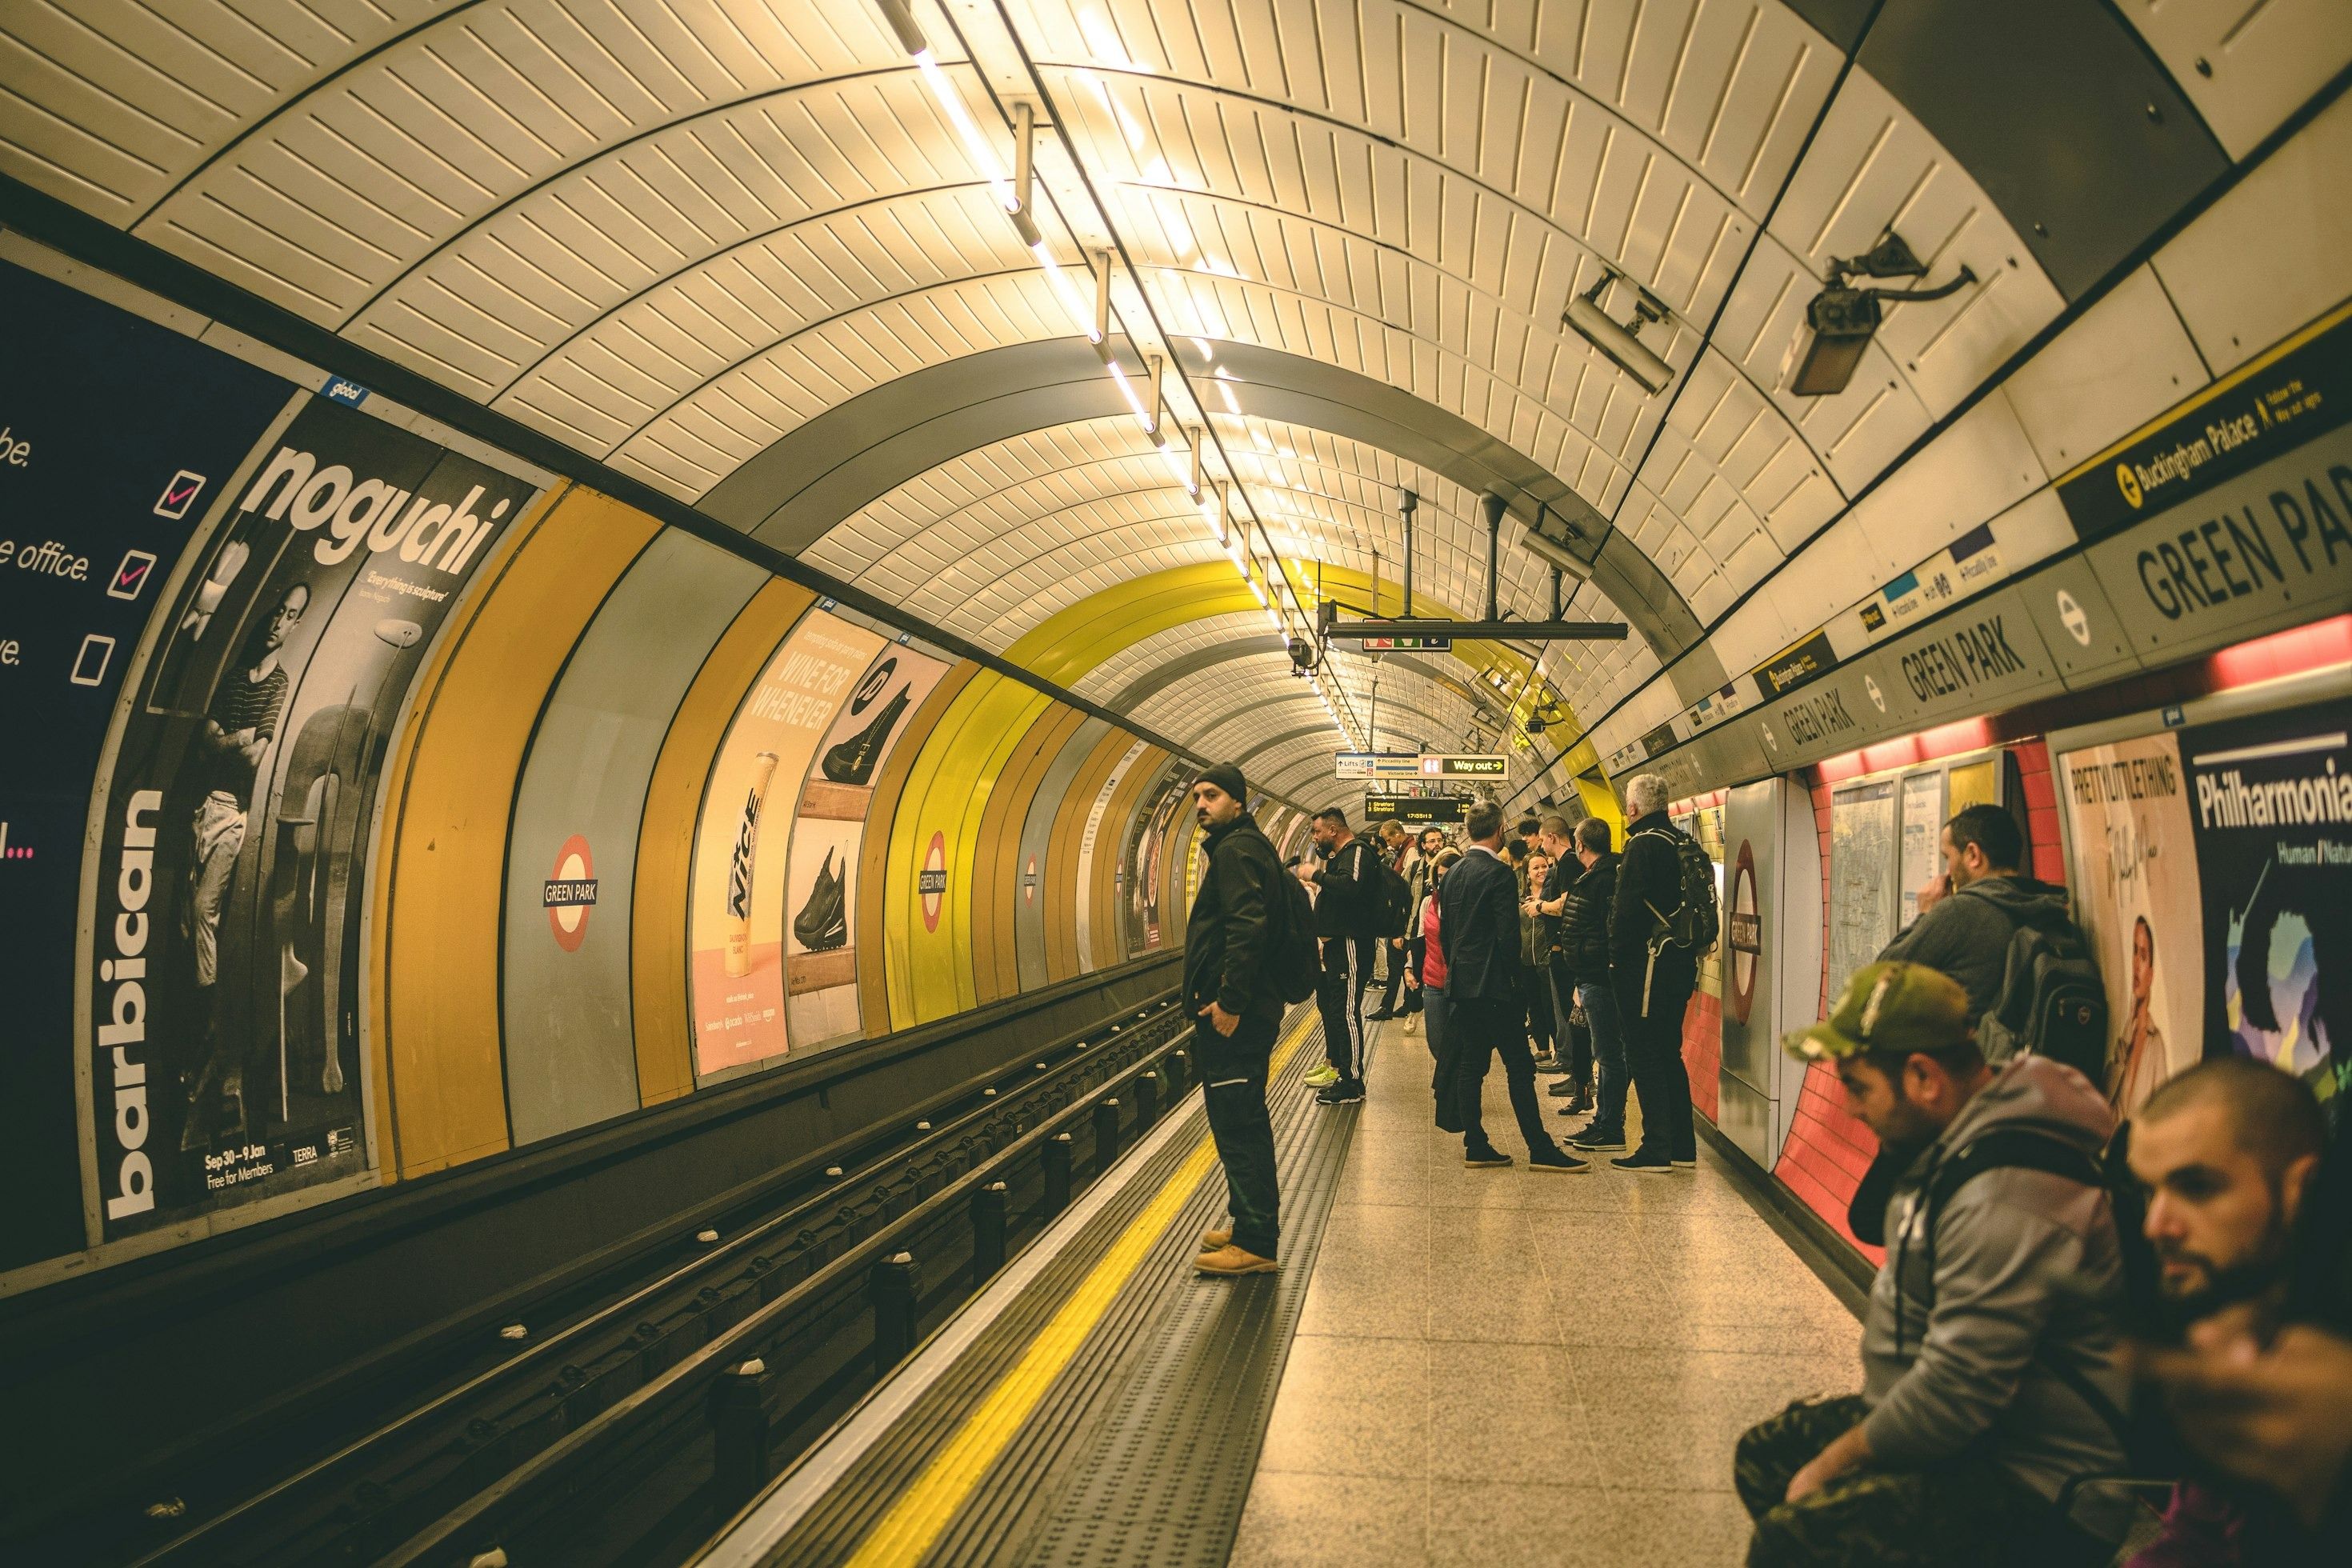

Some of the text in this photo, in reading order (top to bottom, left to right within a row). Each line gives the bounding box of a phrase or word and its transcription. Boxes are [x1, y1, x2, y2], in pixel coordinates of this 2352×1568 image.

[329, 382, 362, 400] global
[2135, 414, 2258, 491] Buckingham Palace
[240, 446, 510, 575] noguchi
[18, 541, 88, 581] office.
[2137, 506, 2284, 620] GREEN
[406, 582, 415, 594] is
[779, 651, 851, 697] WINE FOR
[1902, 614, 2026, 702] GREEN PARK
[857, 670, 888, 701] JD
[751, 684, 833, 730] WHENEVER
[1783, 688, 1855, 746] GREEN PARK
[1454, 761, 1492, 772] Way out
[2196, 756, 2352, 830] Philharmonia
[733, 788, 760, 922] NICE
[2277, 840, 2317, 864] Human
[545, 883, 596, 902] GREEN PARK
[921, 874, 946, 890] GREEN PARK
[1732, 920, 1758, 946] GREEN PARK
[98, 790, 162, 1220] barbican
[205, 1154, 222, 1170] Sep
[223, 1150, 234, 1166] 30
[242, 1146, 249, 1160] 9
[250, 1144, 266, 1159] Jan
[293, 1146, 318, 1163] TERRA
[206, 1162, 274, 1190] Free for Members
